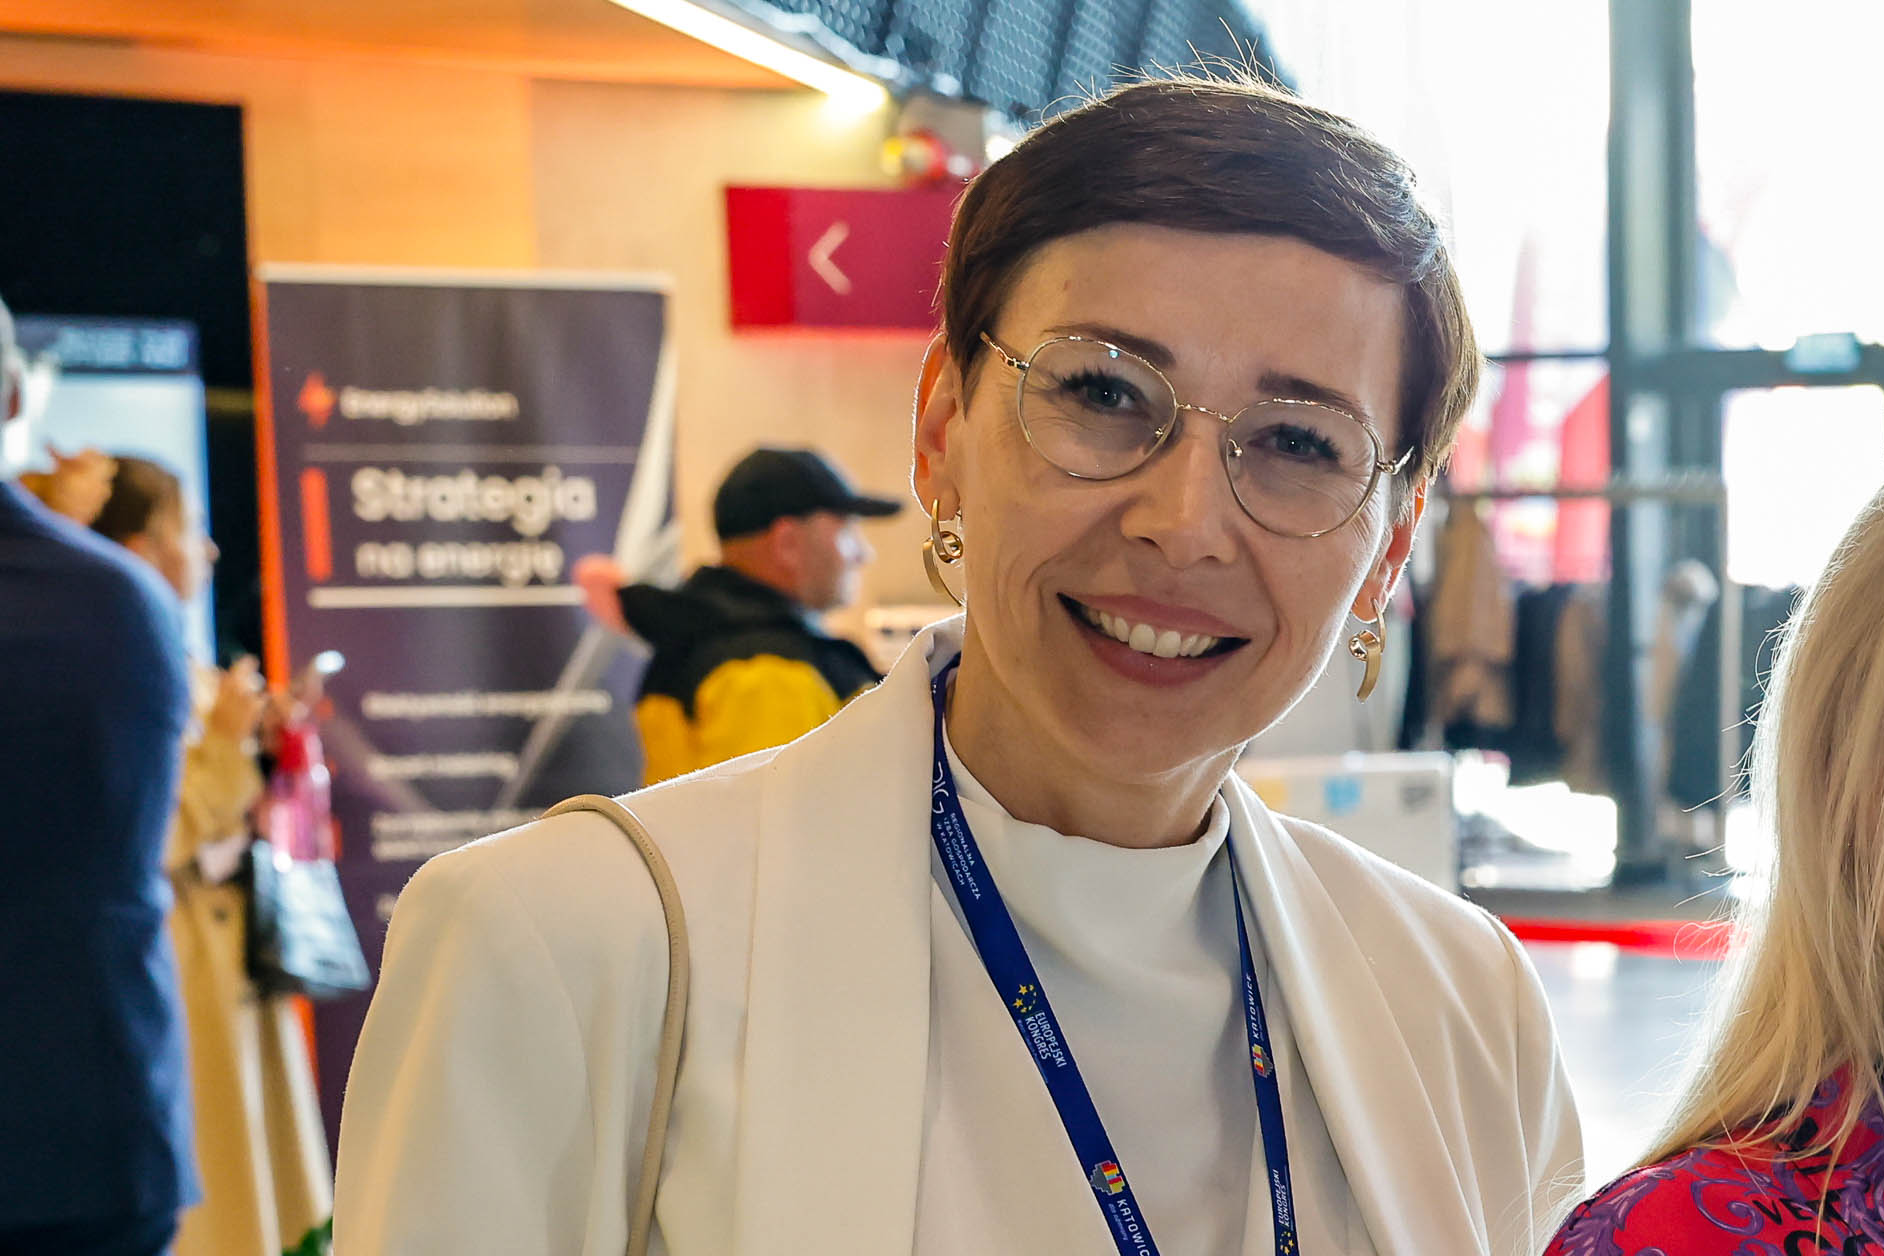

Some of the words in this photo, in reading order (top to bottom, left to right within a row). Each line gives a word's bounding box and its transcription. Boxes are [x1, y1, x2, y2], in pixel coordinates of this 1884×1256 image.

[351, 465, 597, 538] Strategia
[355, 540, 414, 579] na
[940, 831, 965, 886] KATOWICACH
[950, 812, 975, 866] REGIONALNA
[952, 839, 981, 900] GOSPODARCZA
[1025, 1016, 1052, 1060] KONGRES
[1034, 1010, 1067, 1068] EUROPEJSKI
[1273, 1169, 1285, 1225] EUROPEJSKI
[1279, 1184, 1291, 1227] KONGRES
